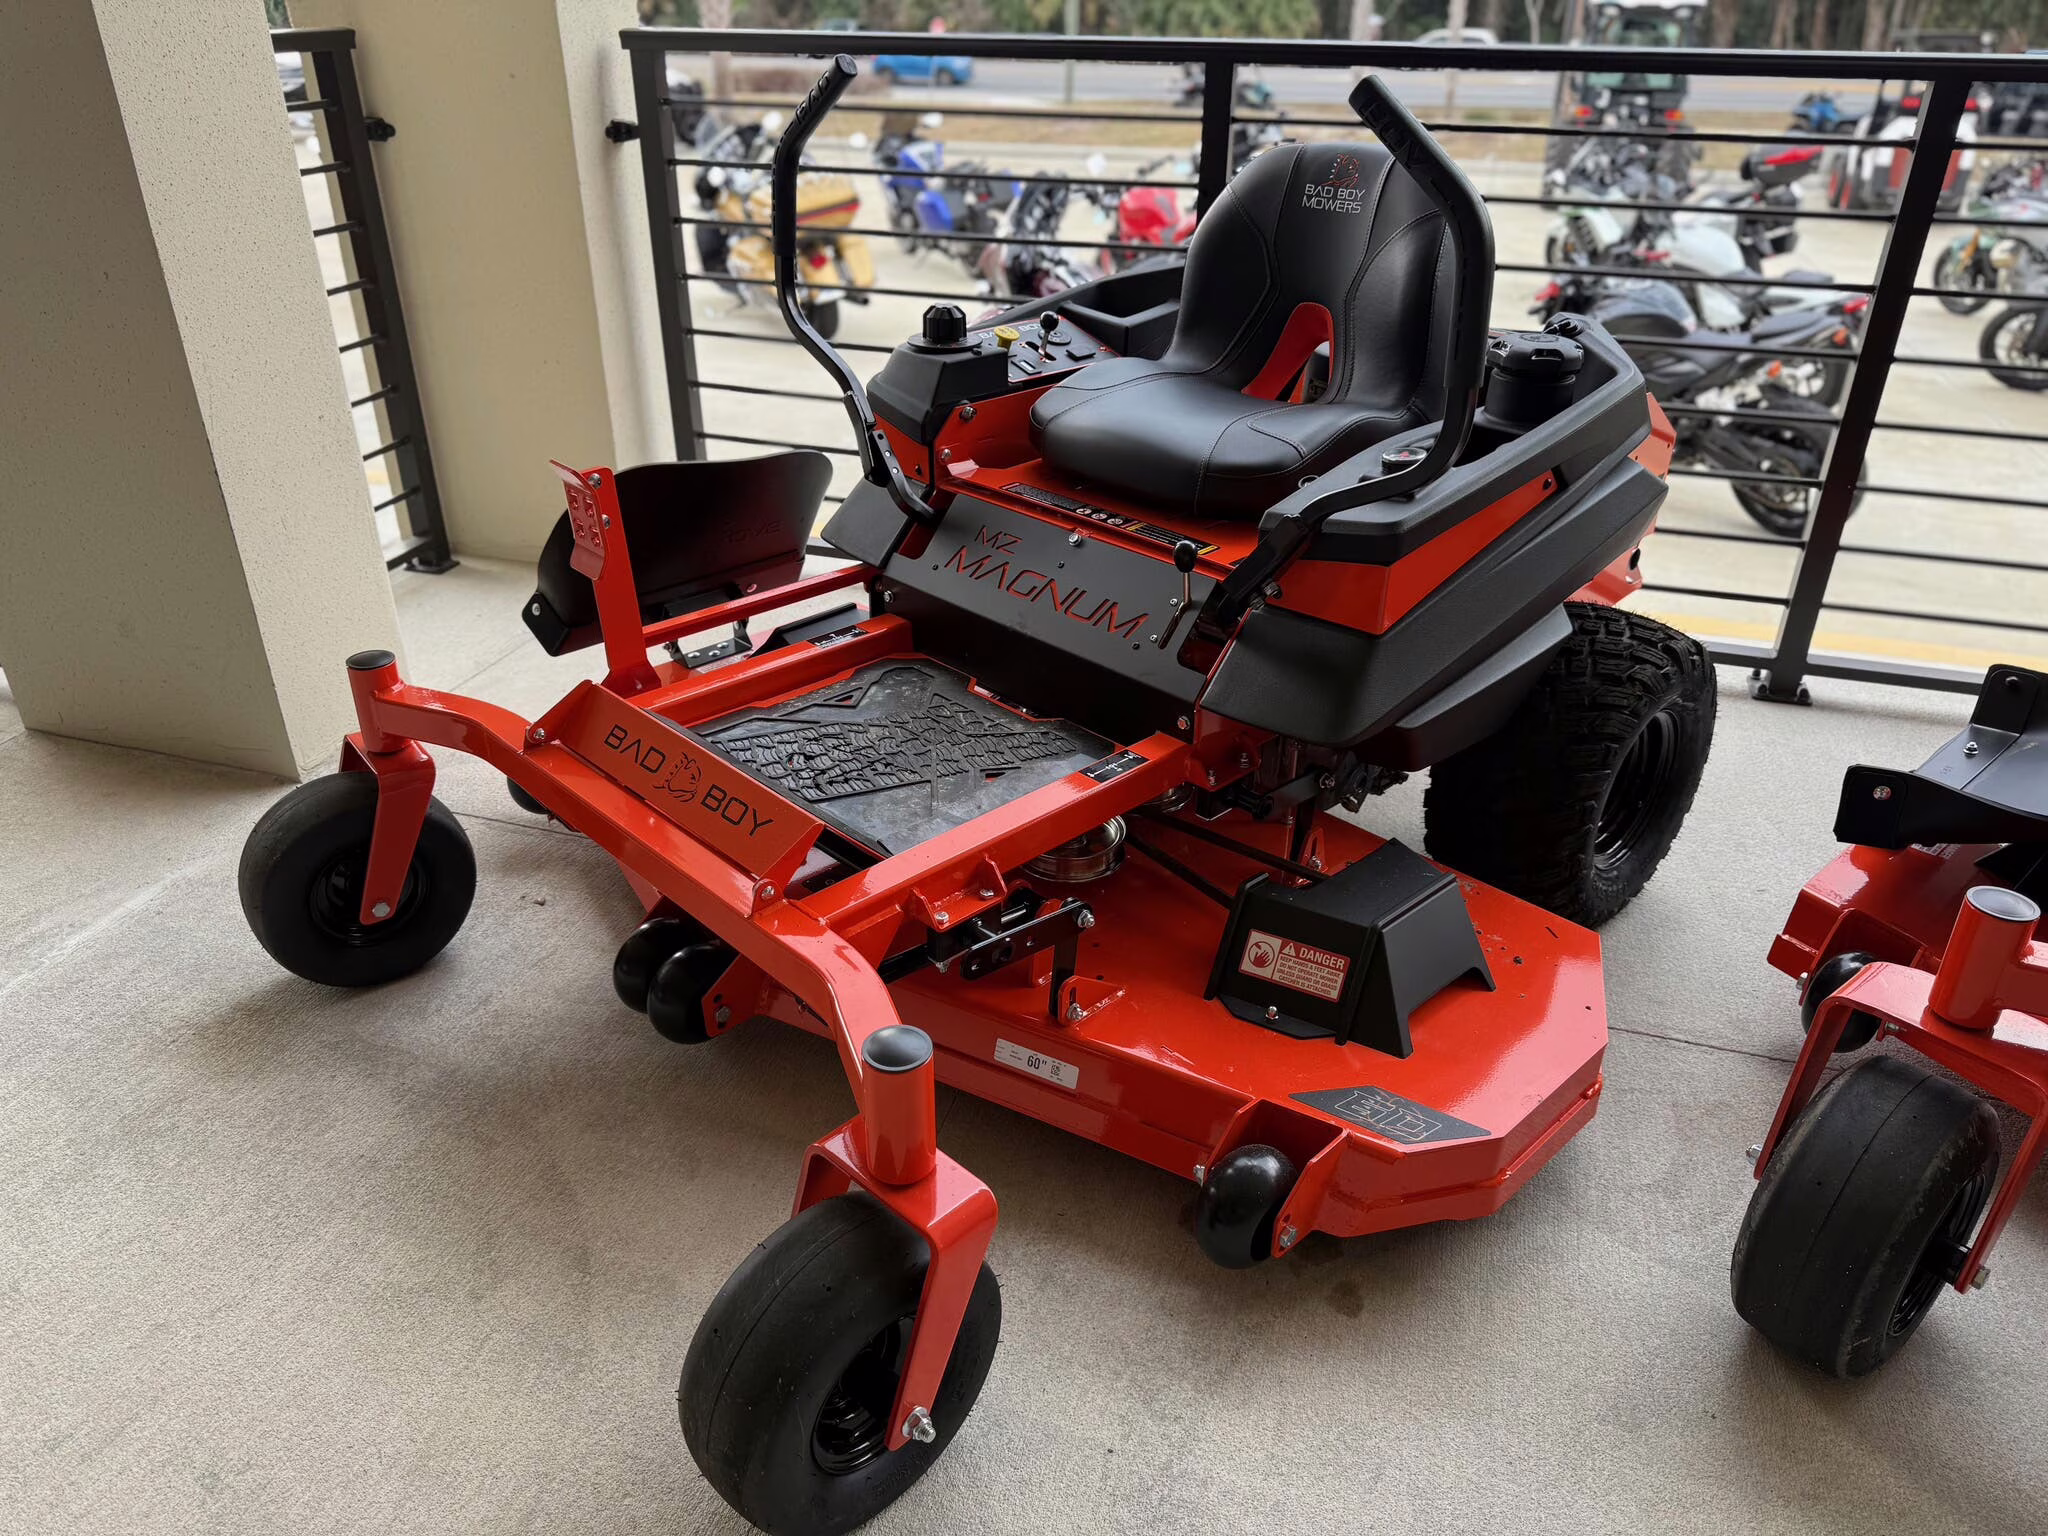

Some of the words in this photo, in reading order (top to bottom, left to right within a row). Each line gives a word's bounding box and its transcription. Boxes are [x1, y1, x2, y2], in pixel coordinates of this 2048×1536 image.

[1305, 184, 1334, 197] BAD
[1337, 188, 1366, 201] BOY
[1302, 195, 1362, 213] MOWERS
[975, 525, 1023, 555] MZ
[944, 545, 1149, 640] MAGNUM
[603, 724, 667, 775] BAD
[700, 783, 774, 837] BOY
[1299, 947, 1345, 970] DANGER
[1297, 967, 1318, 978] OPERATE
[1027, 1055, 1047, 1070] 60"
